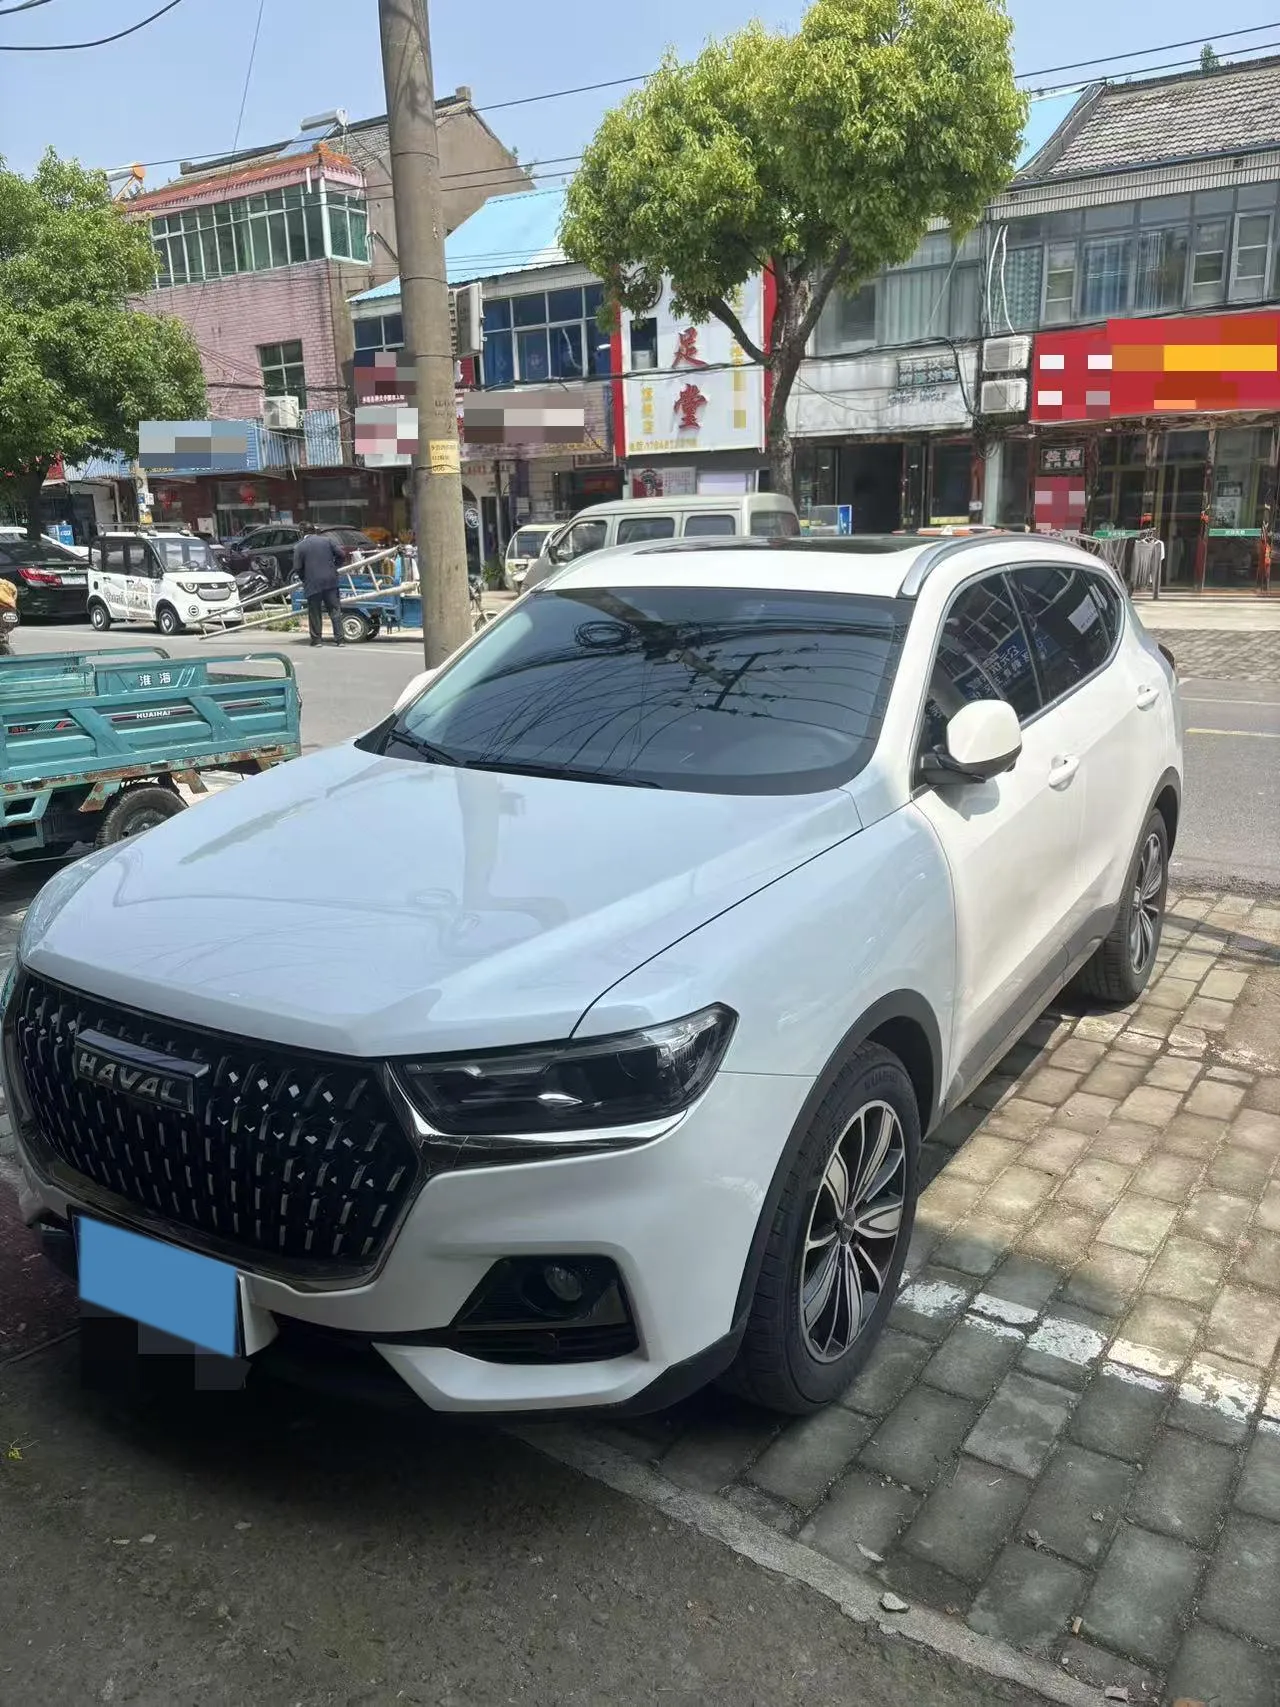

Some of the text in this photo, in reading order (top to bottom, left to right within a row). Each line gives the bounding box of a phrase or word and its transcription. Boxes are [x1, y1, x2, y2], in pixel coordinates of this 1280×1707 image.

[139, 672, 171, 687] 淮海
[136, 710, 171, 719] HUAIHAI
[79, 1052, 183, 1105] HAVAL
